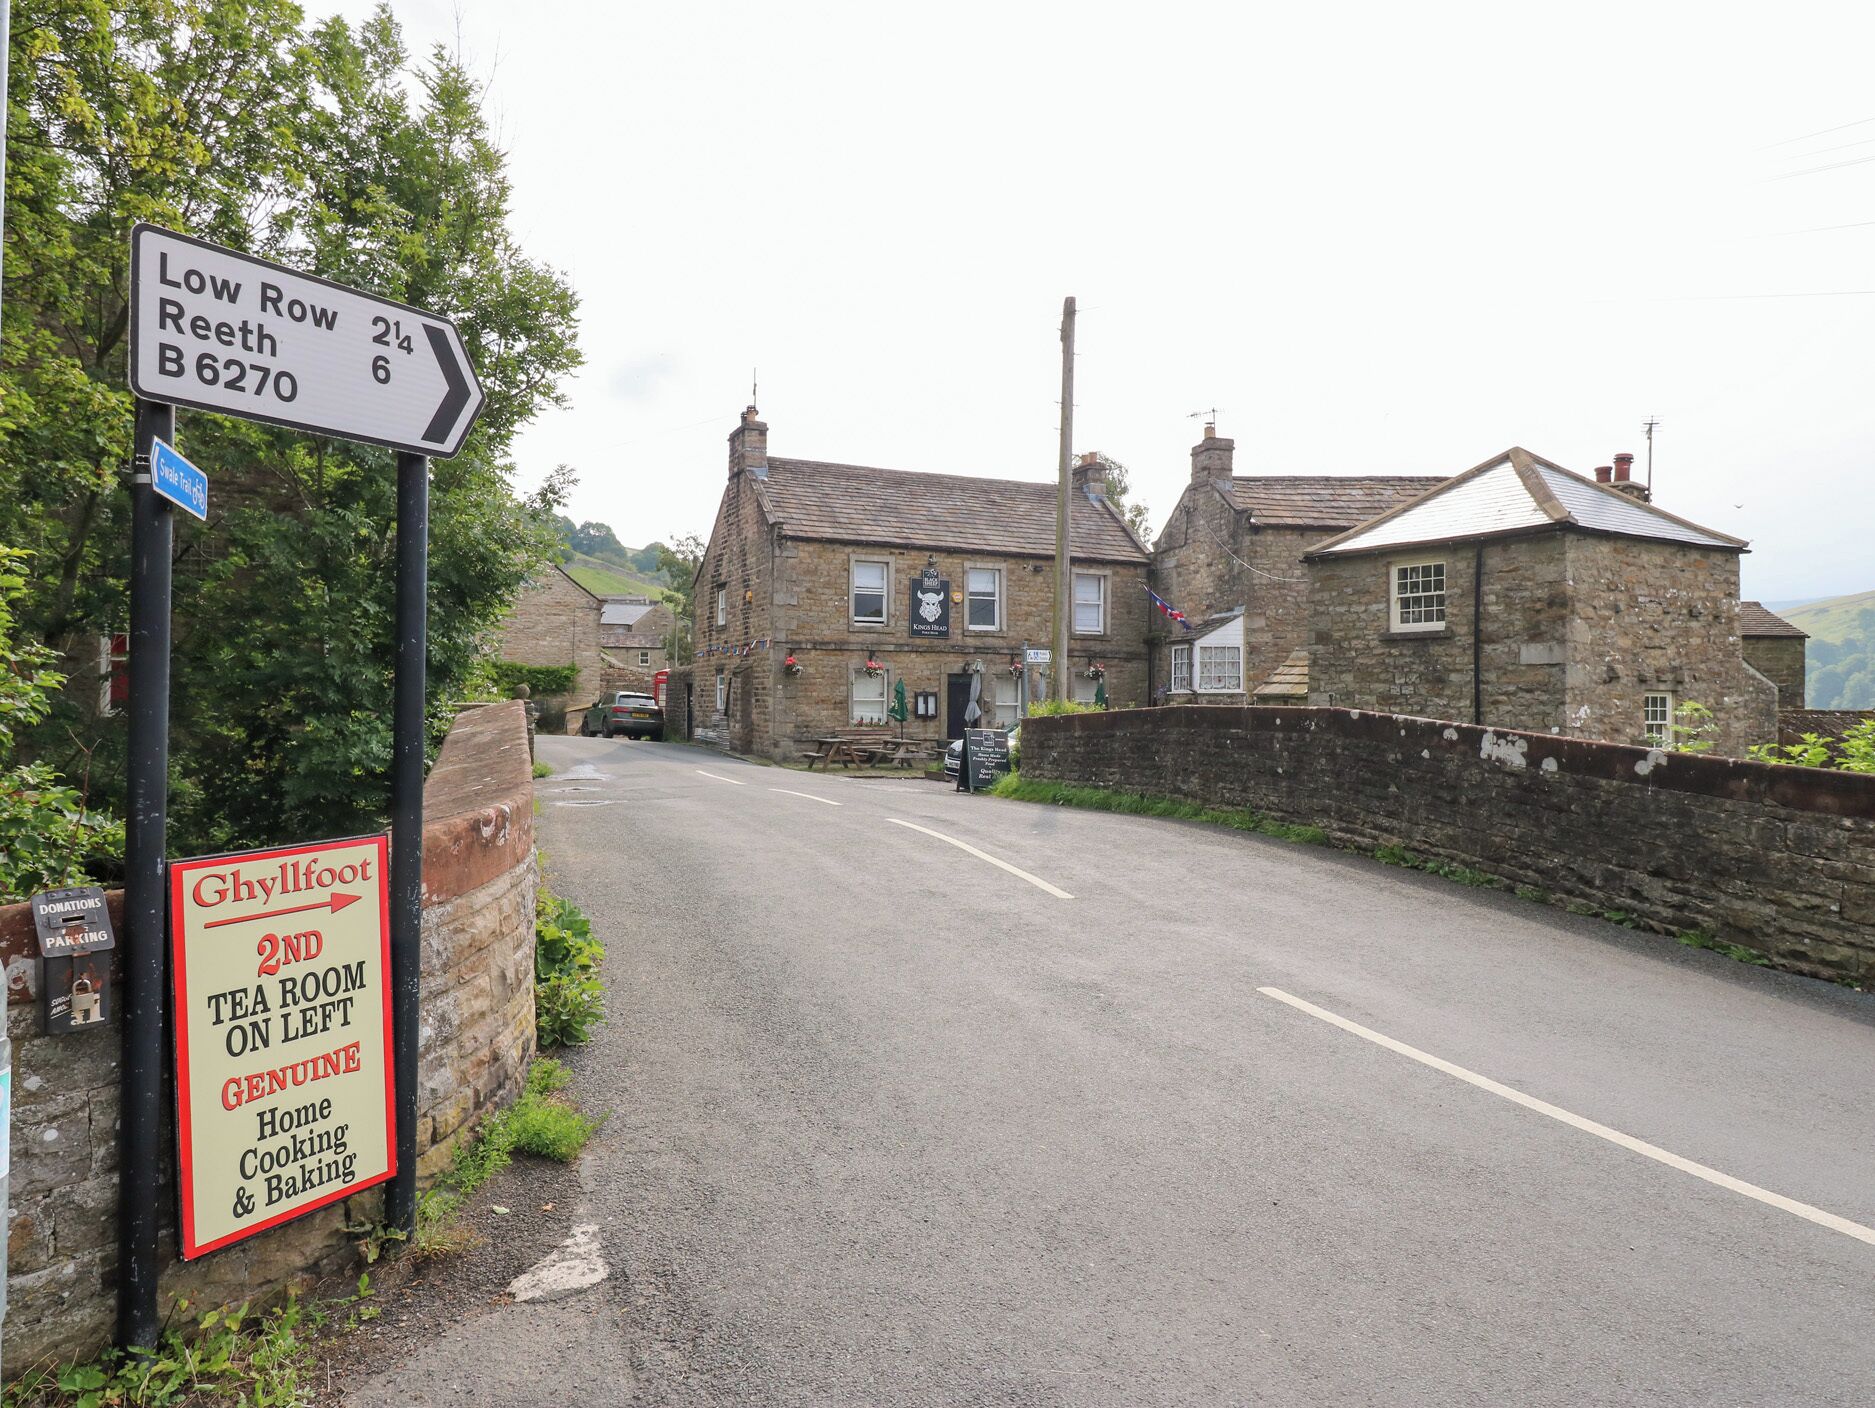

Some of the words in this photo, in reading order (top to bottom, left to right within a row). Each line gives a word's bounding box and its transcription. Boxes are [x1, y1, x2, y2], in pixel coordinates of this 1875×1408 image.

[159, 251, 242, 304] Low
[260, 281, 338, 331] Row
[159, 297, 278, 357] Reeth
[372, 355, 391, 384] 6
[160, 458, 178, 486] Swale
[180, 472, 192, 495] Trail
[39, 898, 102, 915] DONATIONS
[193, 857, 373, 908] Ghyllfoot
[45, 930, 108, 949] PARKING
[257, 929, 323, 978] 2ND
[207, 983, 269, 1026] TEA
[279, 961, 367, 1003] ROOM
[226, 1017, 271, 1058] ON
[282, 997, 355, 1045] LEFT
[221, 1041, 362, 1111] GENUINE
[256, 1098, 332, 1142] Home
[239, 1123, 350, 1181] Cooking
[232, 1186, 255, 1219] &
[264, 1153, 357, 1206] Baking
